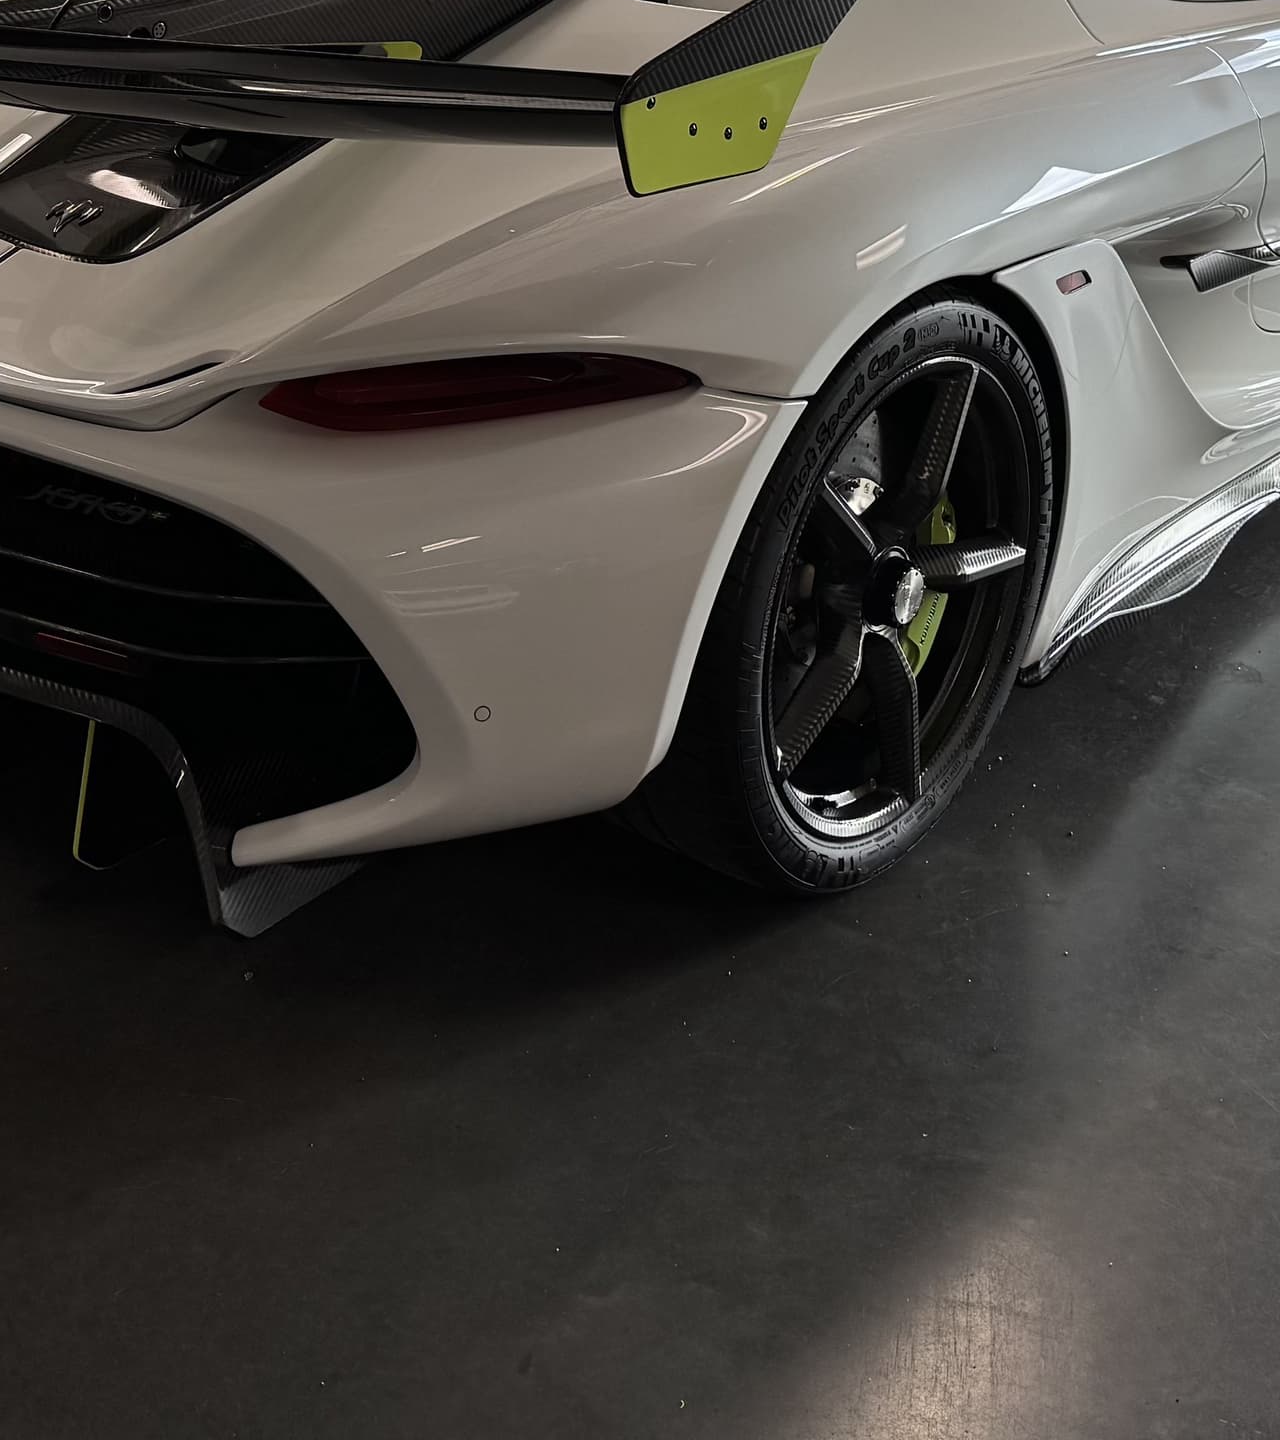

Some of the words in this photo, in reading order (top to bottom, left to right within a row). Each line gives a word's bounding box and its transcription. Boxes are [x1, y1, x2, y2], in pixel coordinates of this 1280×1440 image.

[776, 448, 818, 527] Pilot
[815, 372, 864, 453] Sport
[867, 344, 901, 379] Cup
[903, 327, 916, 351] 2
[1012, 347, 1054, 486] MICHELIN
